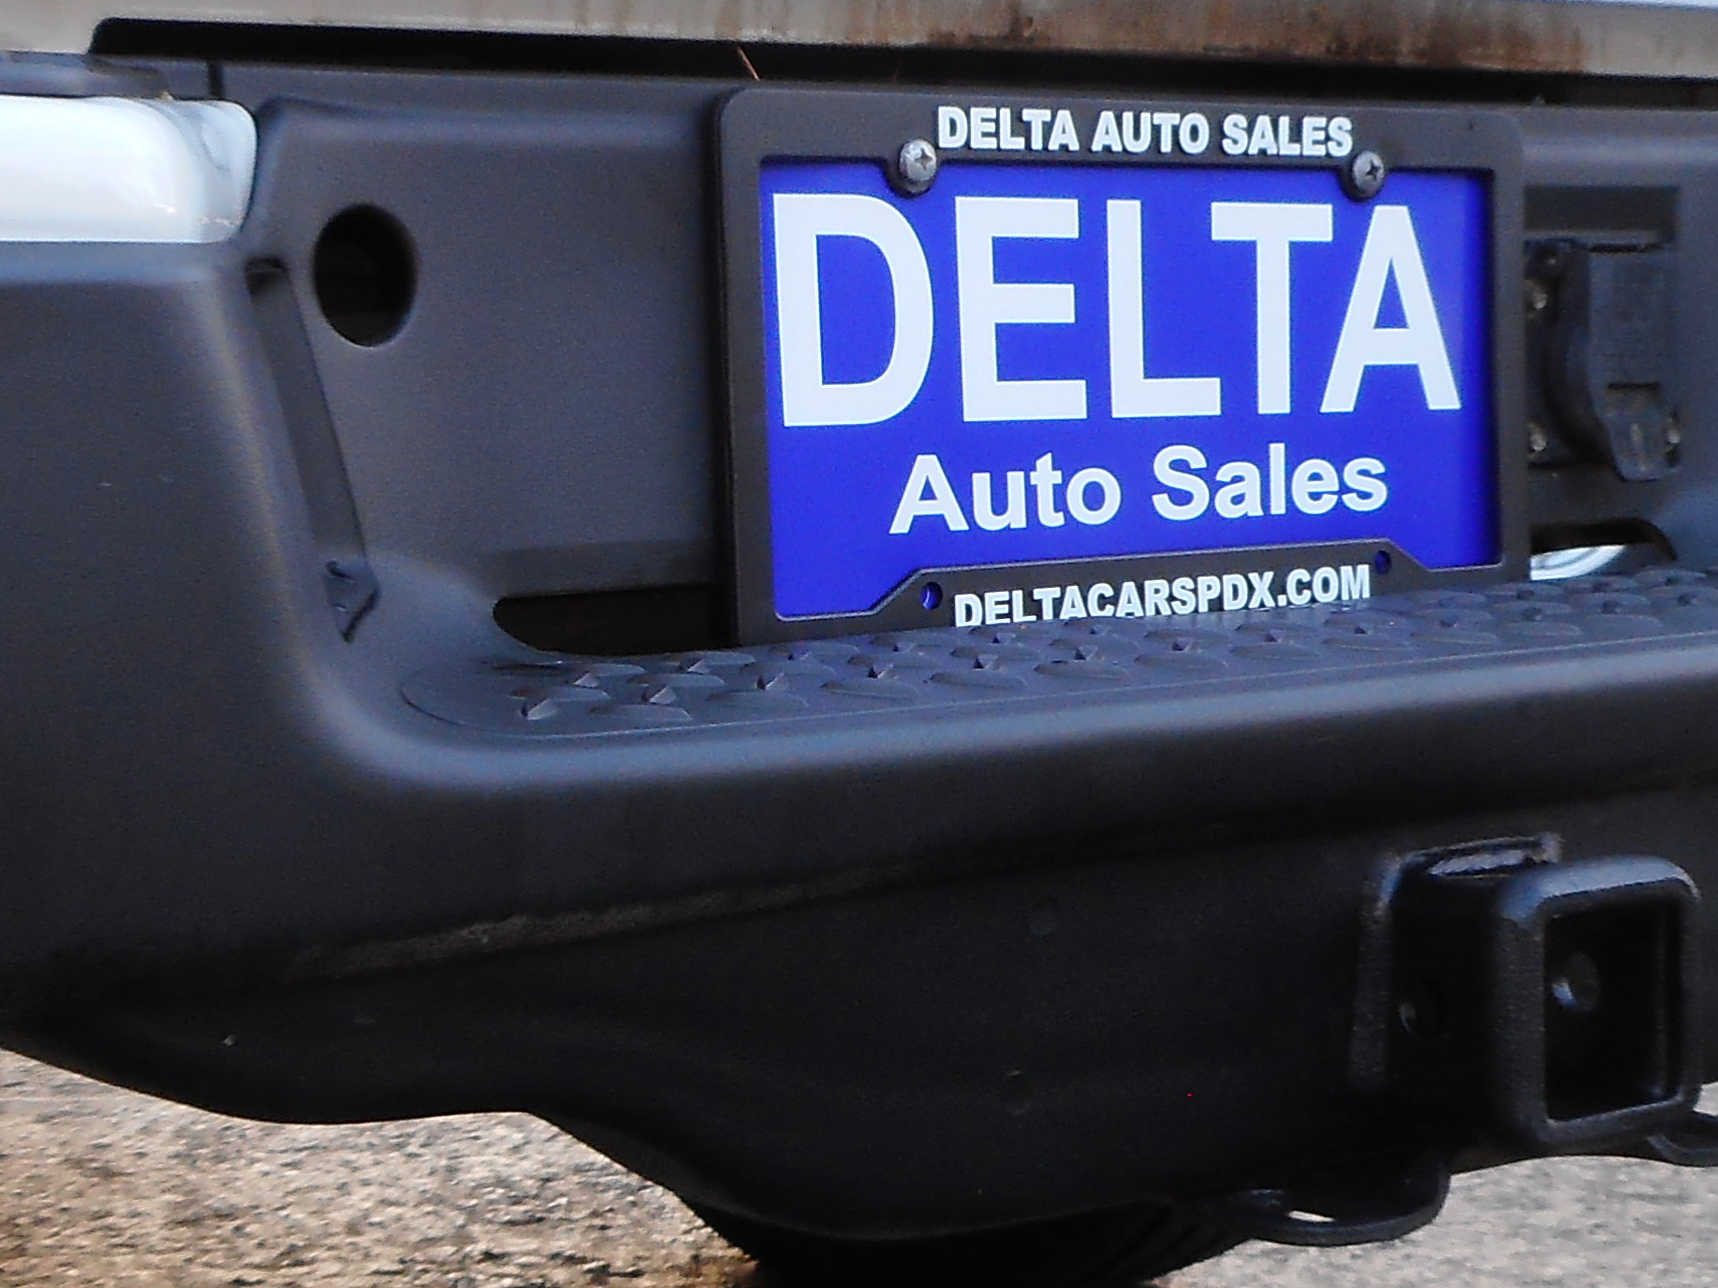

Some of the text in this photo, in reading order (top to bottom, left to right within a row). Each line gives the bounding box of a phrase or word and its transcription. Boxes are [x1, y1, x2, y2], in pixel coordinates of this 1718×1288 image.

[937, 105, 1354, 158] DELTA AUTO SALES
[772, 192, 1462, 428] DELTA
[888, 443, 1389, 535] Auto Sales
[954, 563, 1371, 628] DELTACARSPDX.COM
